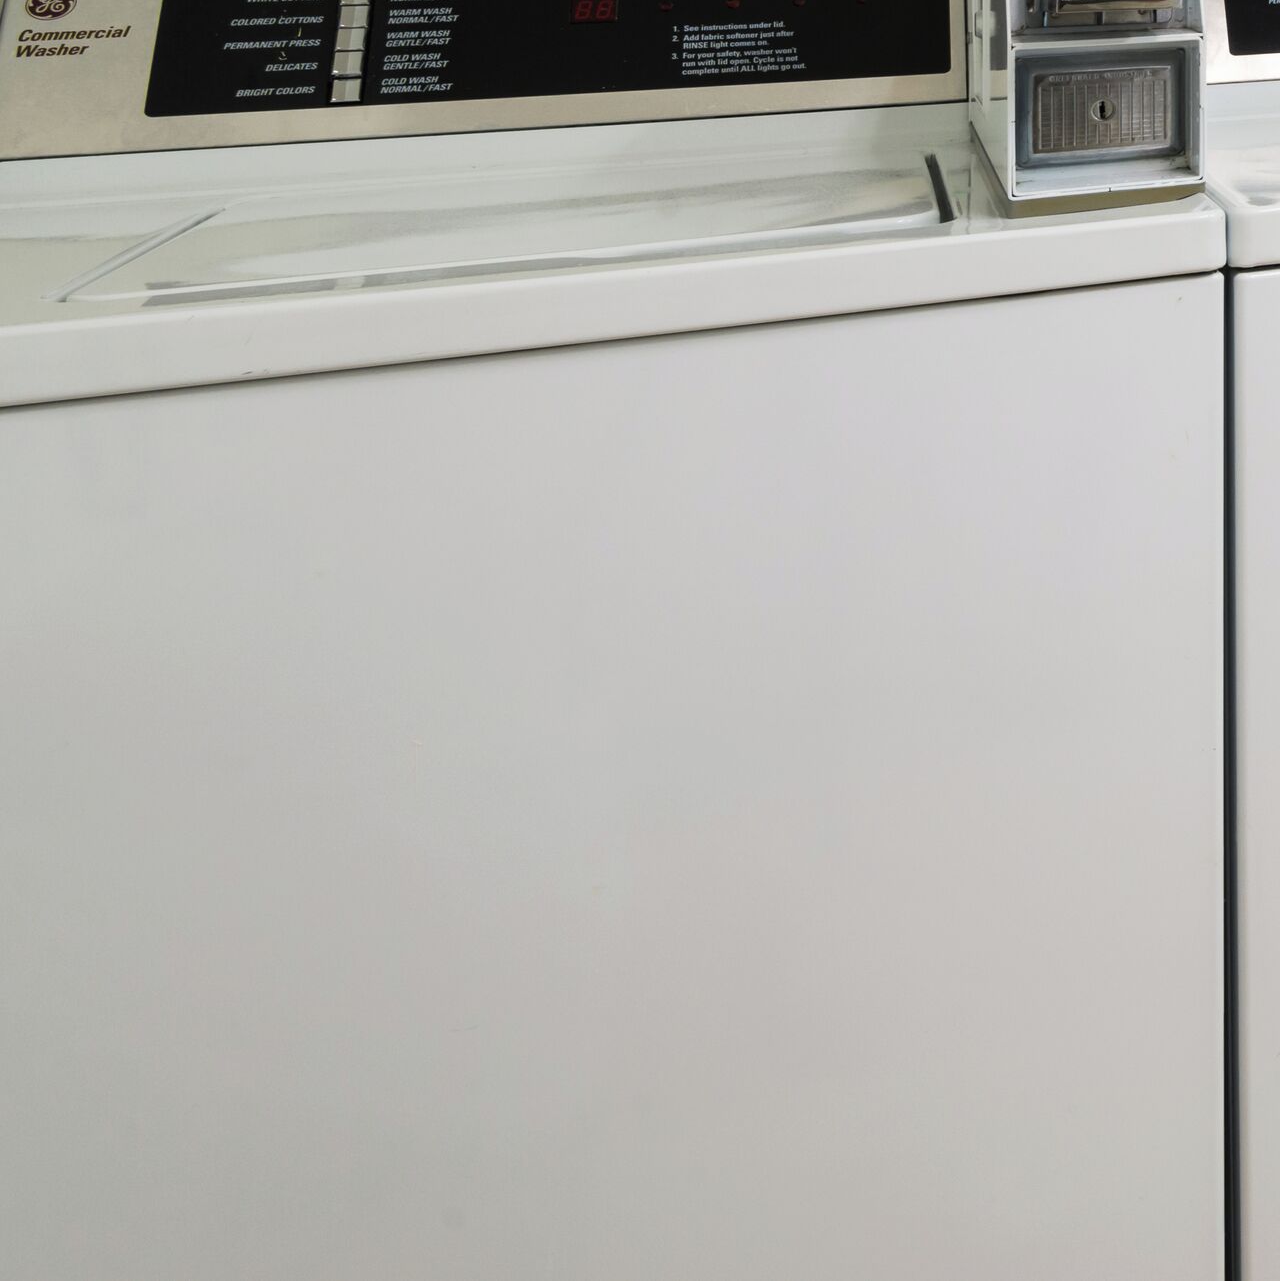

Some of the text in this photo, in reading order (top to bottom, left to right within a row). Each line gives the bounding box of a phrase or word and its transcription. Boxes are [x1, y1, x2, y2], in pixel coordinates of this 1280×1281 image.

[389, 7, 453, 17] WARM WASH
[230, 16, 324, 26] COLORED COTTONS
[701, 23, 747, 31] instructions
[18, 25, 131, 42] Commercial
[386, 30, 451, 39] WARM WASH
[701, 33, 724, 41] fabric
[726, 32, 758, 40] softener
[760, 31, 775, 39] just
[223, 39, 321, 50] PERMANENT PRESS
[683, 41, 709, 50] RINSE
[710, 41, 728, 49] light
[16, 44, 90, 58] Washer
[697, 52, 715, 60] your
[716, 50, 742, 58] safety,
[383, 53, 441, 62] COLD WASH
[729, 58, 751, 66] open.
[753, 56, 776, 64] Cycle
[265, 62, 319, 72] DELICATES
[682, 67, 719, 76] complete
[381, 76, 439, 86] COLD WASH
[235, 86, 316, 97] BRIGHT COLORS
